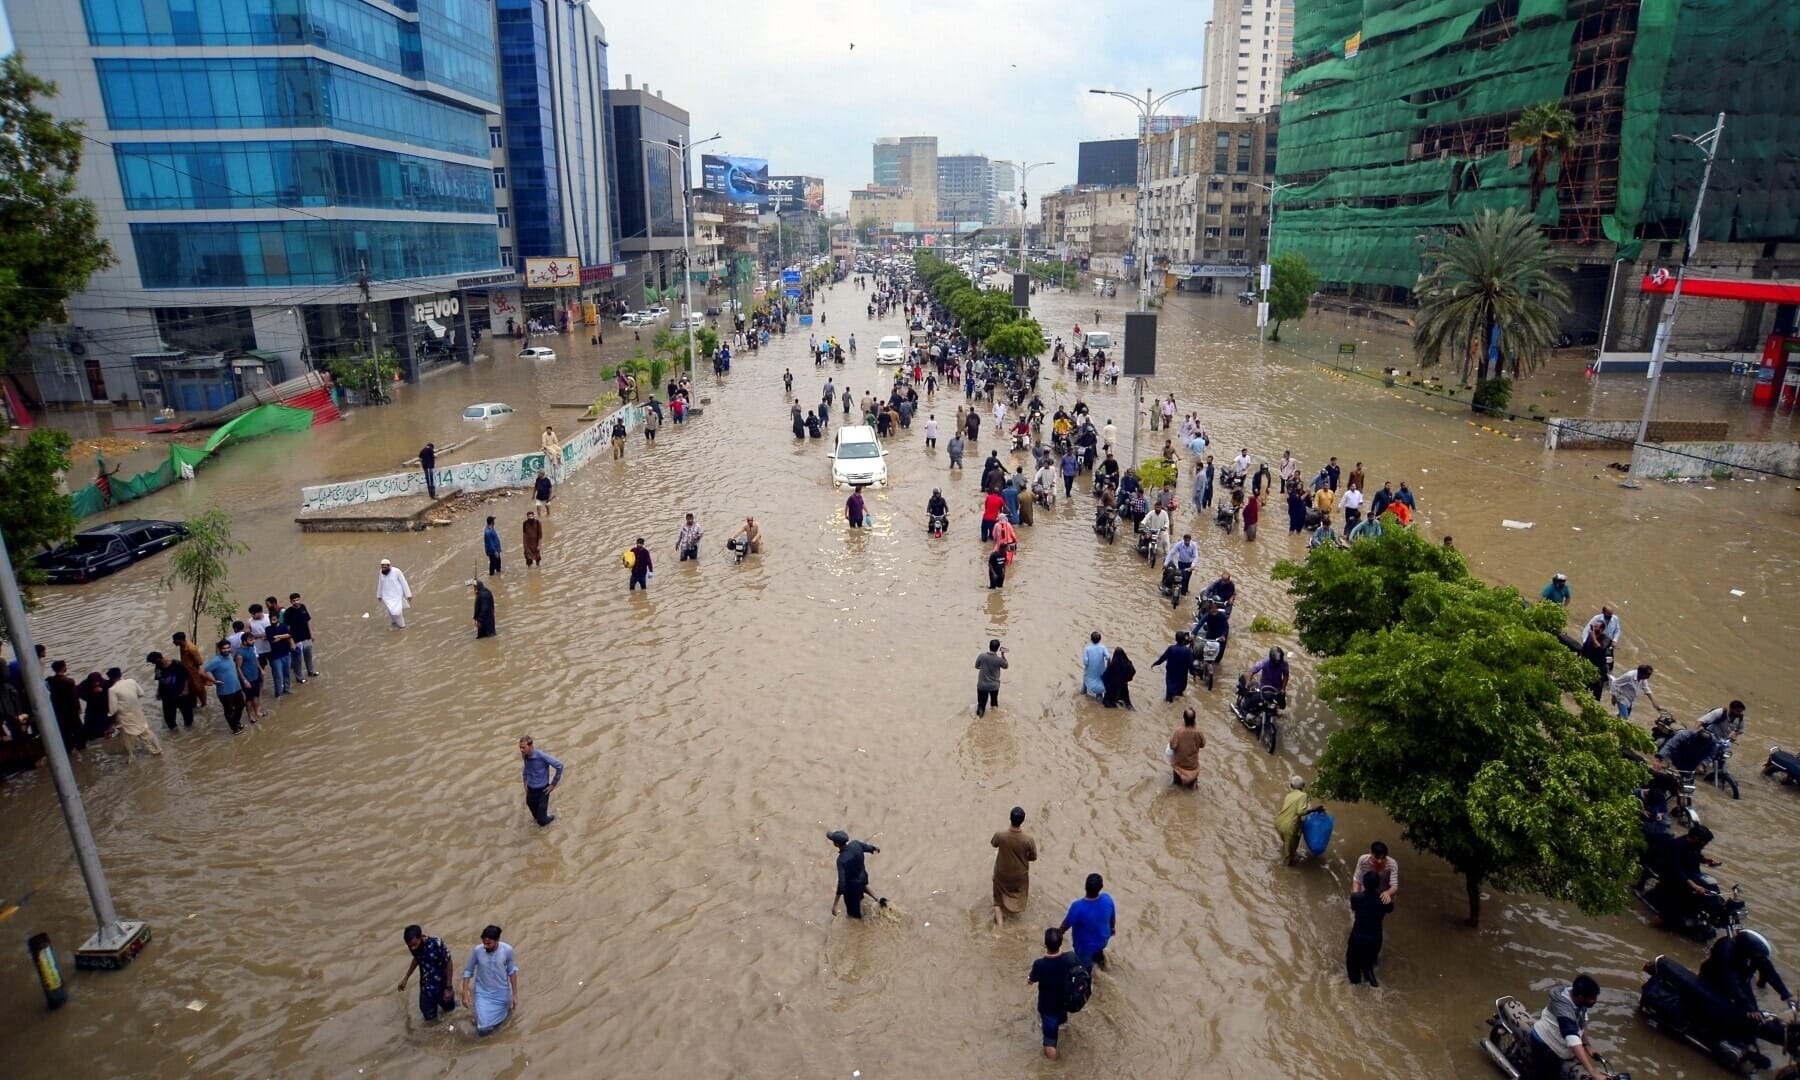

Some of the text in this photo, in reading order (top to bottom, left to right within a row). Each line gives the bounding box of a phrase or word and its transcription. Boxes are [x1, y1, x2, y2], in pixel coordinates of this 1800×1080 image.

[768, 179, 794, 190] KFC
[414, 297, 459, 322] REVOO
[436, 469, 453, 487] 14
